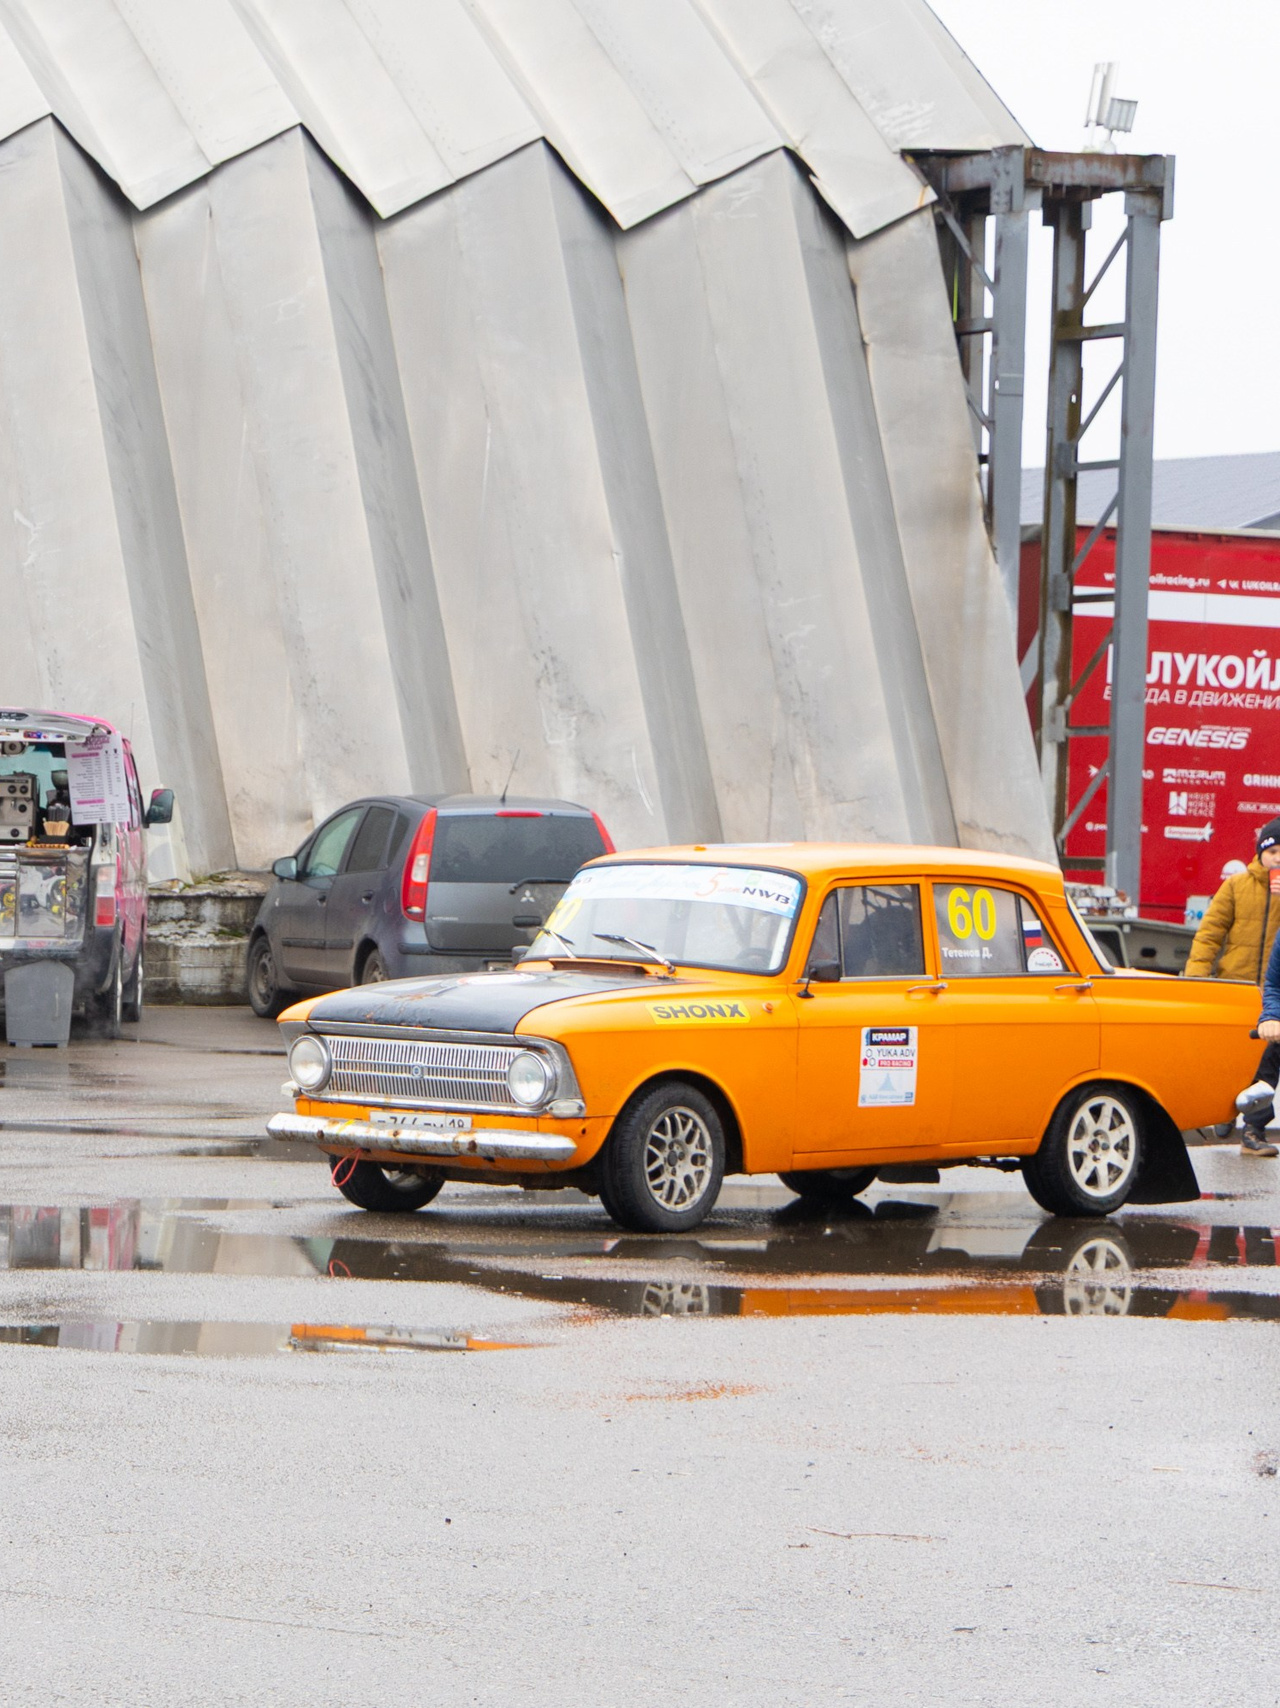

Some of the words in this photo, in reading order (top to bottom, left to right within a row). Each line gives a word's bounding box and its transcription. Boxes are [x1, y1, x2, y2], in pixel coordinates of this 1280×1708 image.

[1174, 689, 1188, 705] В
[1147, 727, 1249, 749] GENESIS
[743, 887, 791, 905] NWB
[947, 887, 997, 941] 60
[653, 1004, 746, 1019] SHONX
[877, 1048, 898, 1058] YUKA
